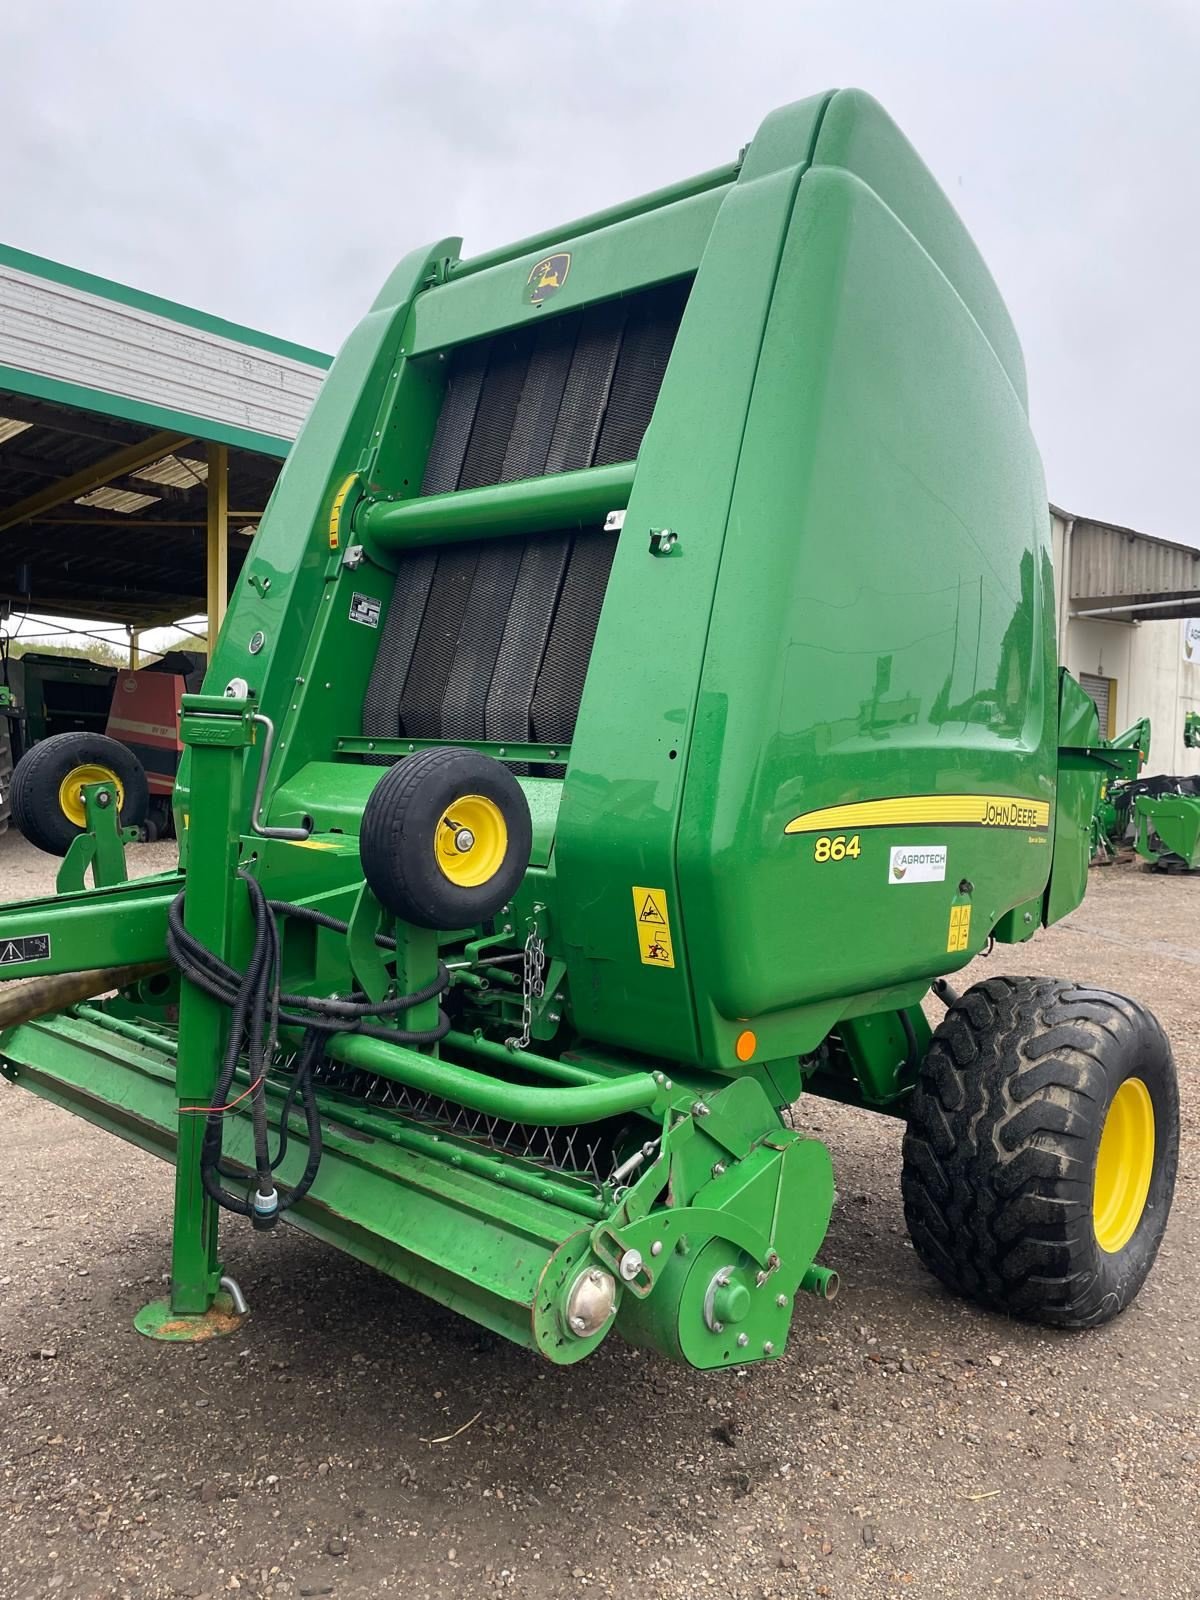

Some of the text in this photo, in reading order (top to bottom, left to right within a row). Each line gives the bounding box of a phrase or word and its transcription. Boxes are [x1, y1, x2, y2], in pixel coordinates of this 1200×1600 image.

[982, 802, 1037, 824] JOHN DEERE
[814, 834, 861, 863] 864
[901, 854, 945, 864] AGROTECH
